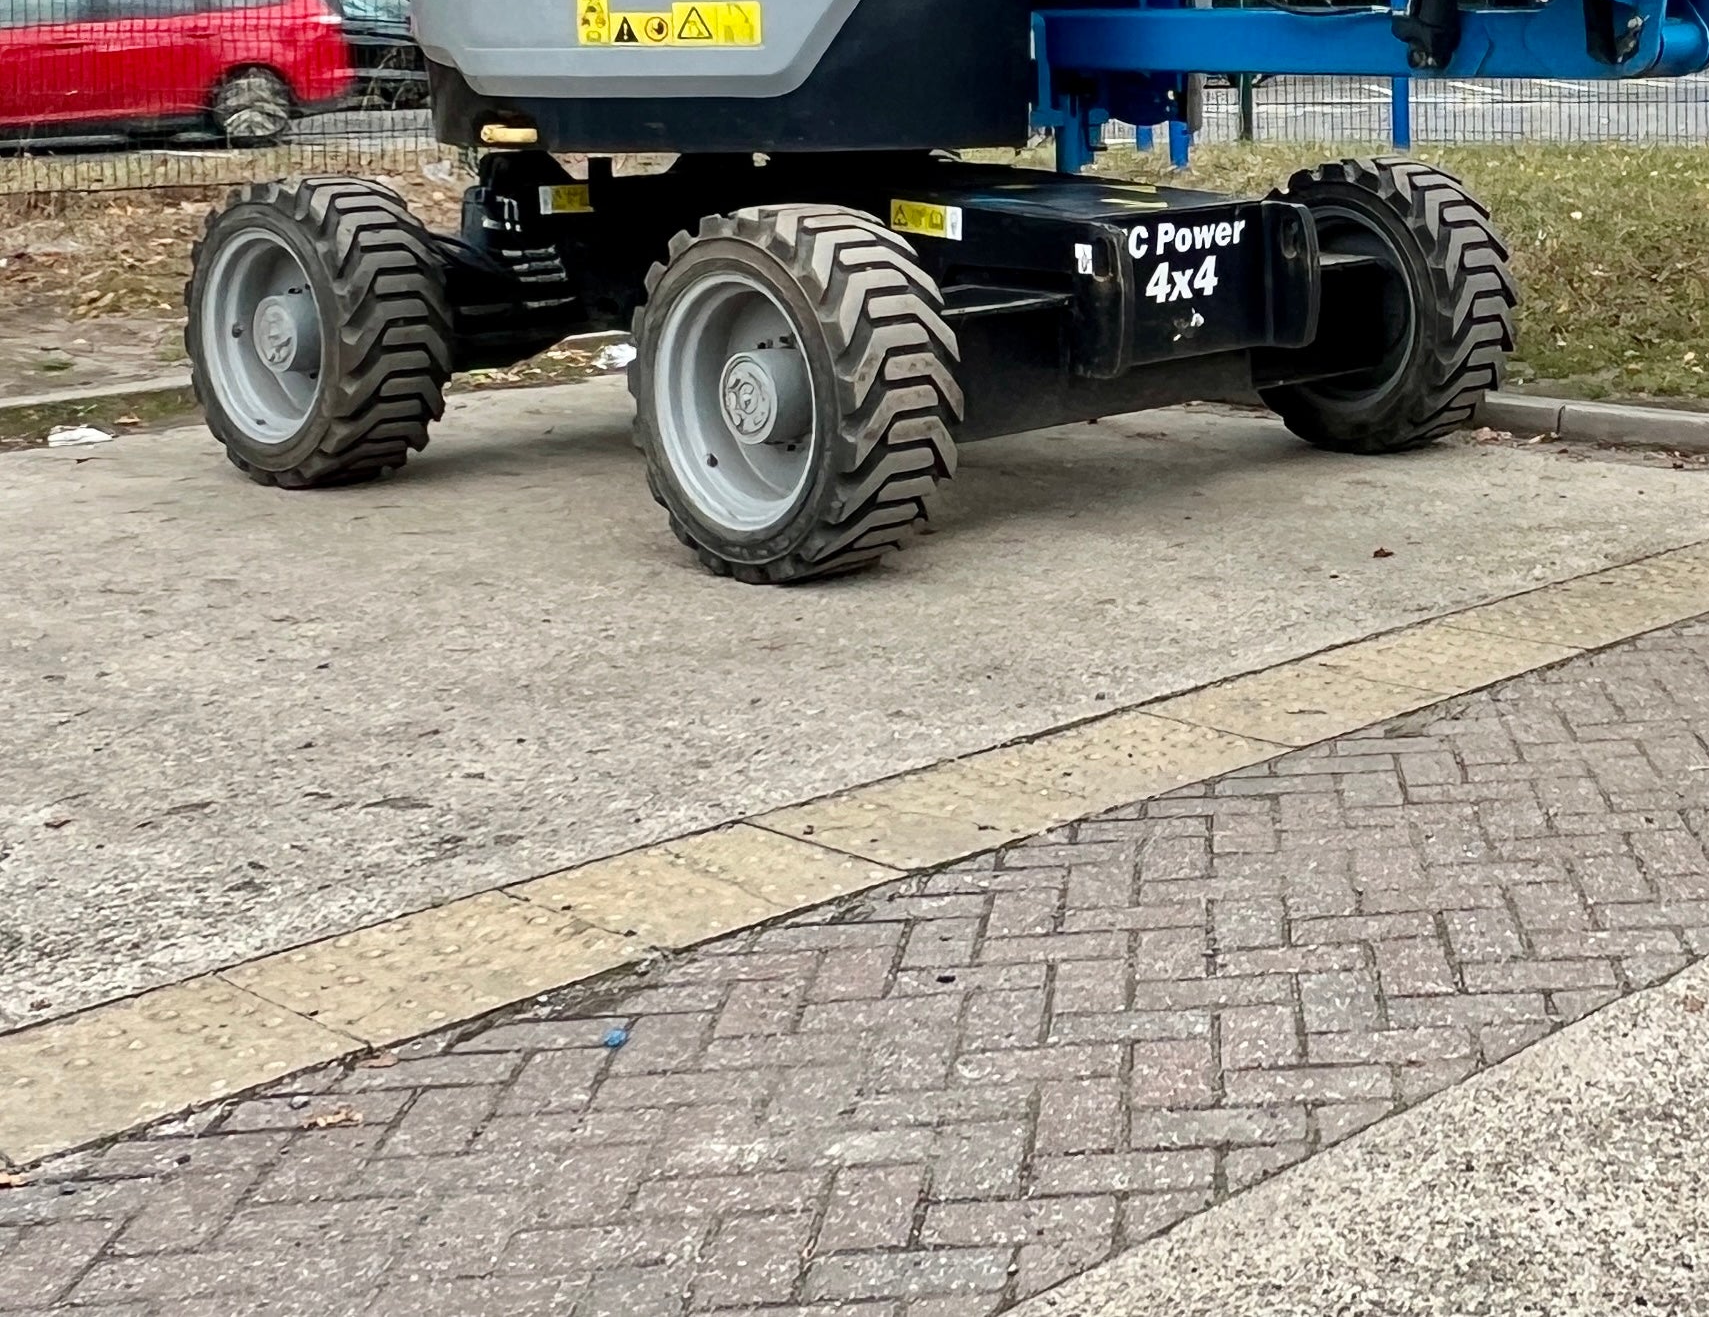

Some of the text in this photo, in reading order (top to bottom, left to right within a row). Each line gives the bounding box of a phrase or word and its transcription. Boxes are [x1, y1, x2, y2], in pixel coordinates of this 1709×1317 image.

[1121, 219, 1246, 259] C Power
[1144, 254, 1219, 304] 4x4
